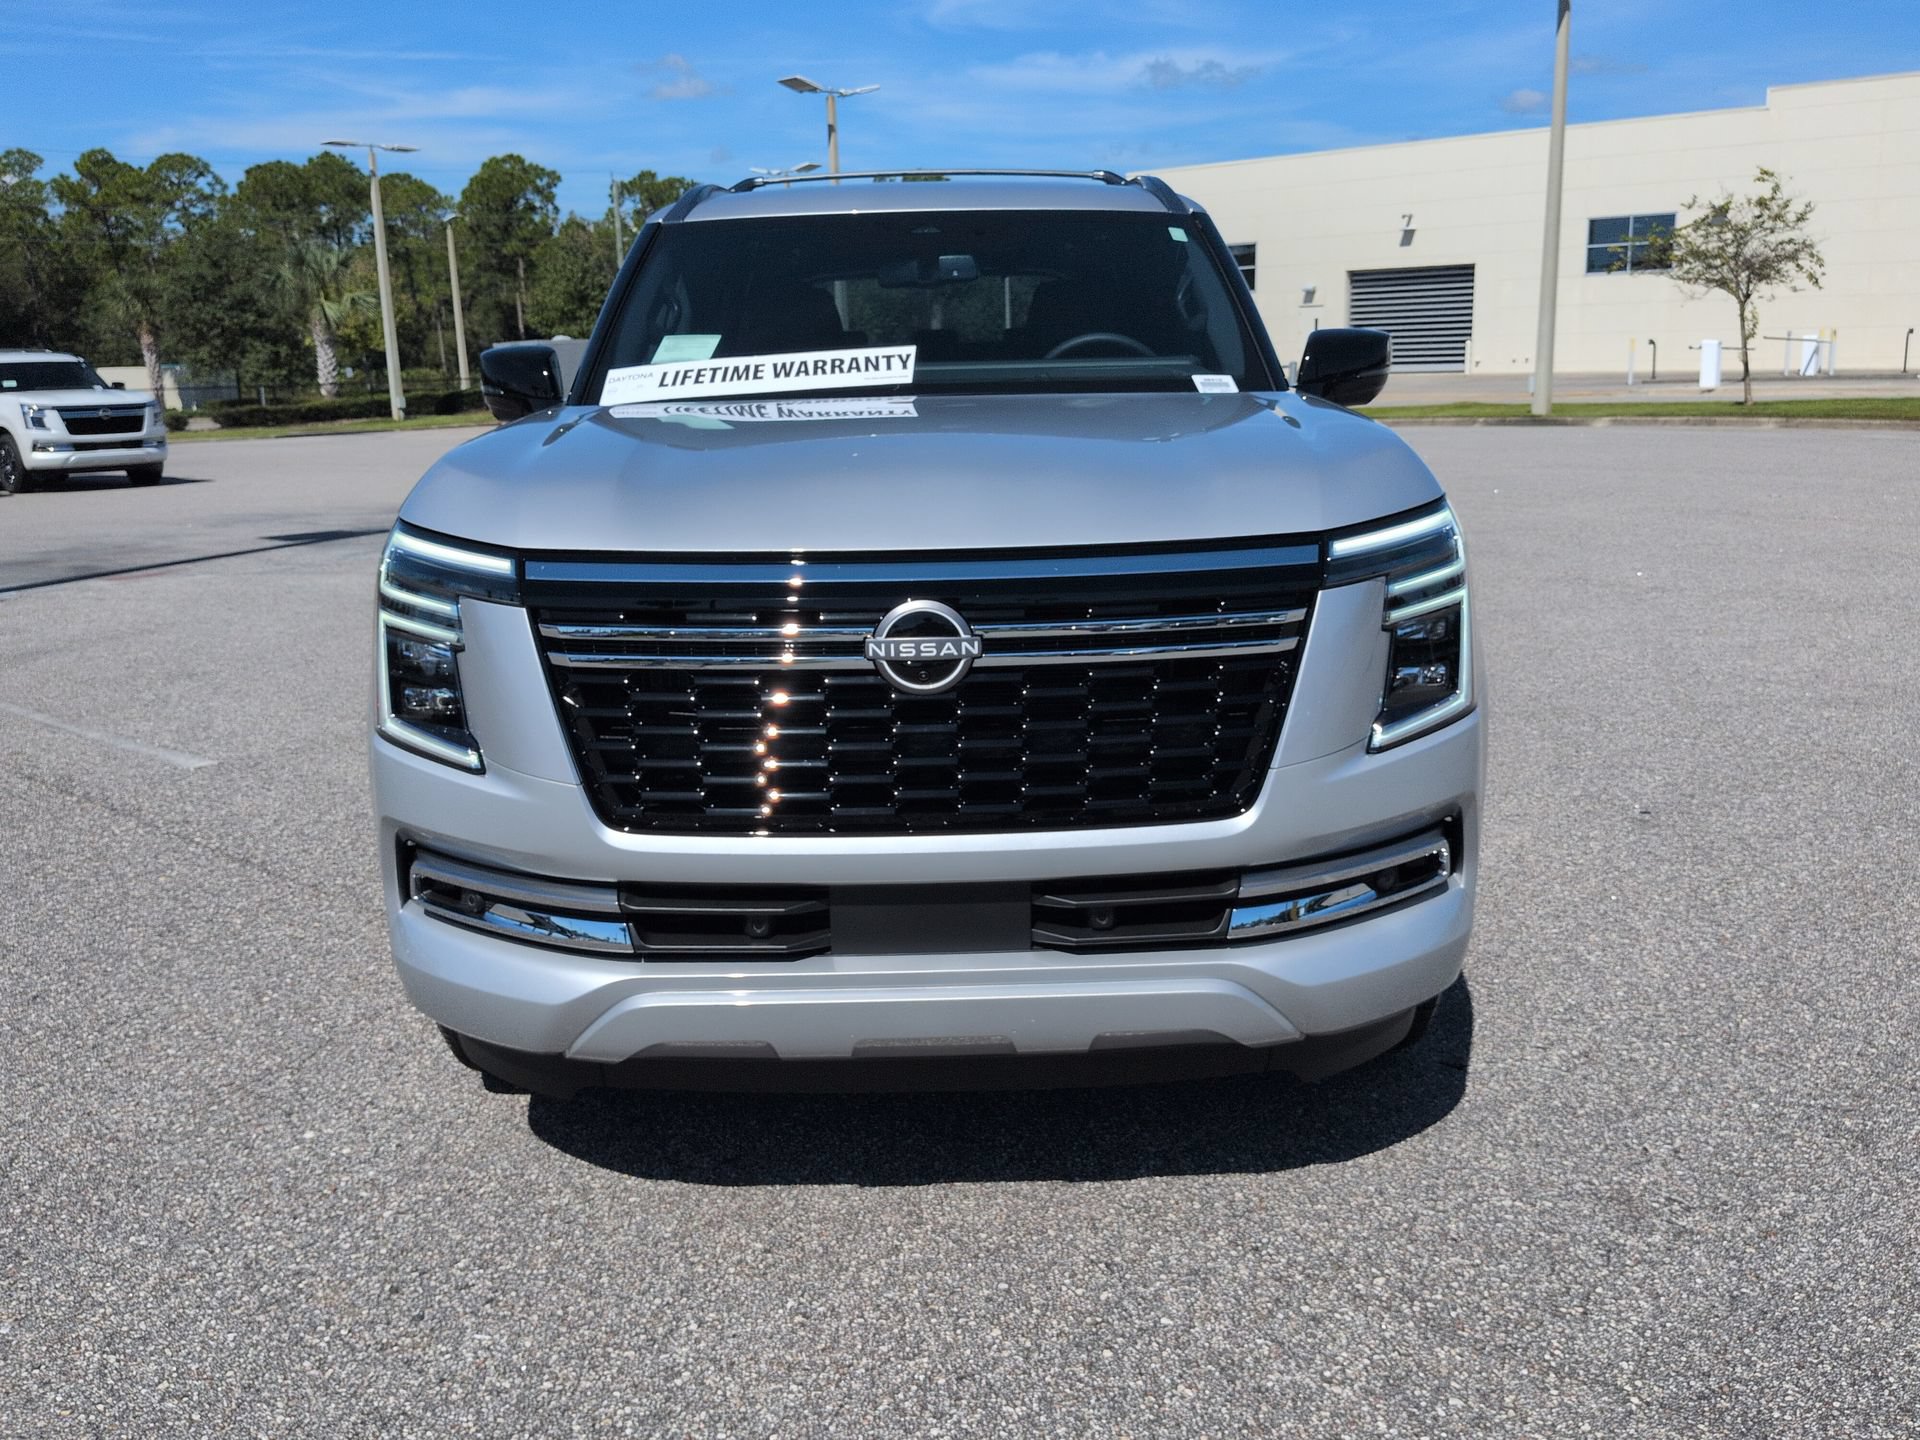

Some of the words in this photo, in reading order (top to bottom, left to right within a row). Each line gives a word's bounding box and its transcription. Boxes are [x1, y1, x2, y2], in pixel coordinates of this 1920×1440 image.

[658, 363, 765, 387] LIFETIME
[772, 353, 911, 379] WARRANTY
[868, 640, 979, 657] NISSAN
